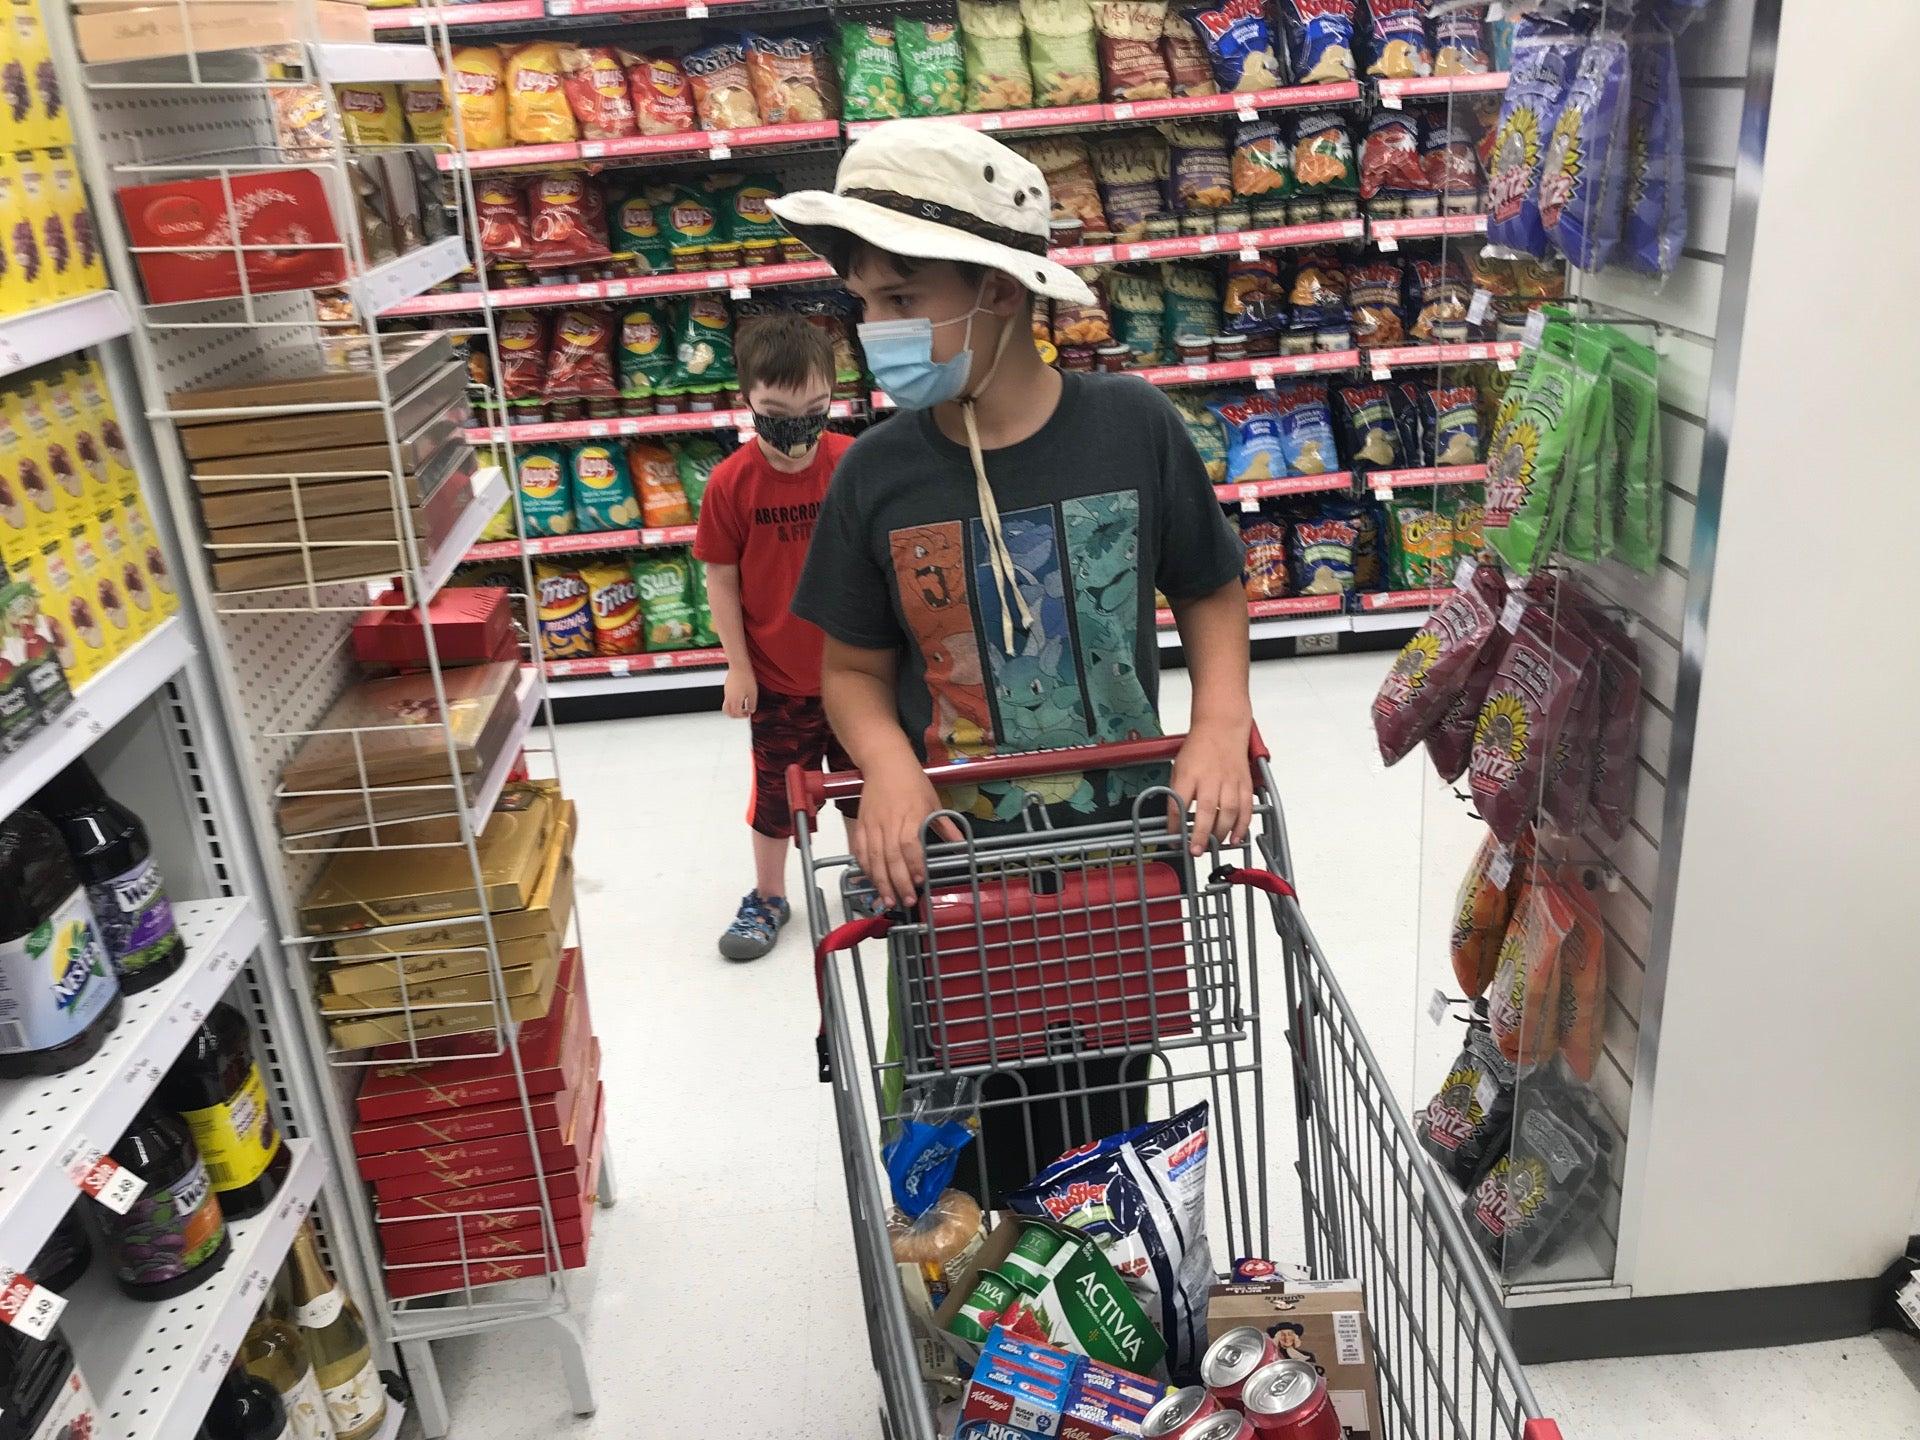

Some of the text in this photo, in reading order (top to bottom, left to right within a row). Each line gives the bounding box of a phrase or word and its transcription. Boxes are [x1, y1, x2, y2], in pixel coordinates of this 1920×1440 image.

[919, 202, 942, 220] SC
[754, 502, 820, 525] ABERCRO
[540, 575, 588, 606] Fritos
[593, 581, 637, 617] Frito
[1427, 1101, 1475, 1138] Spitz
[84, 1163, 114, 1191] Sale
[110, 1178, 135, 1203] 2.49
[1043, 1181, 1109, 1222] Ruffles
[1476, 1177, 1525, 1230] Spitz
[1, 1283, 30, 1315] Sale
[28, 1299, 52, 1327] 2.49
[1076, 1272, 1143, 1362] ACTIVIA
[1083, 1373, 1115, 1385] FROSTED
[971, 1389, 1010, 1412] Kellogg's
[1014, 1405, 1035, 1417] SUGAR
[1075, 1403, 1108, 1416] FROSTED
[1015, 1412, 1032, 1421] WISE
[987, 1422, 1022, 1440] RICE
